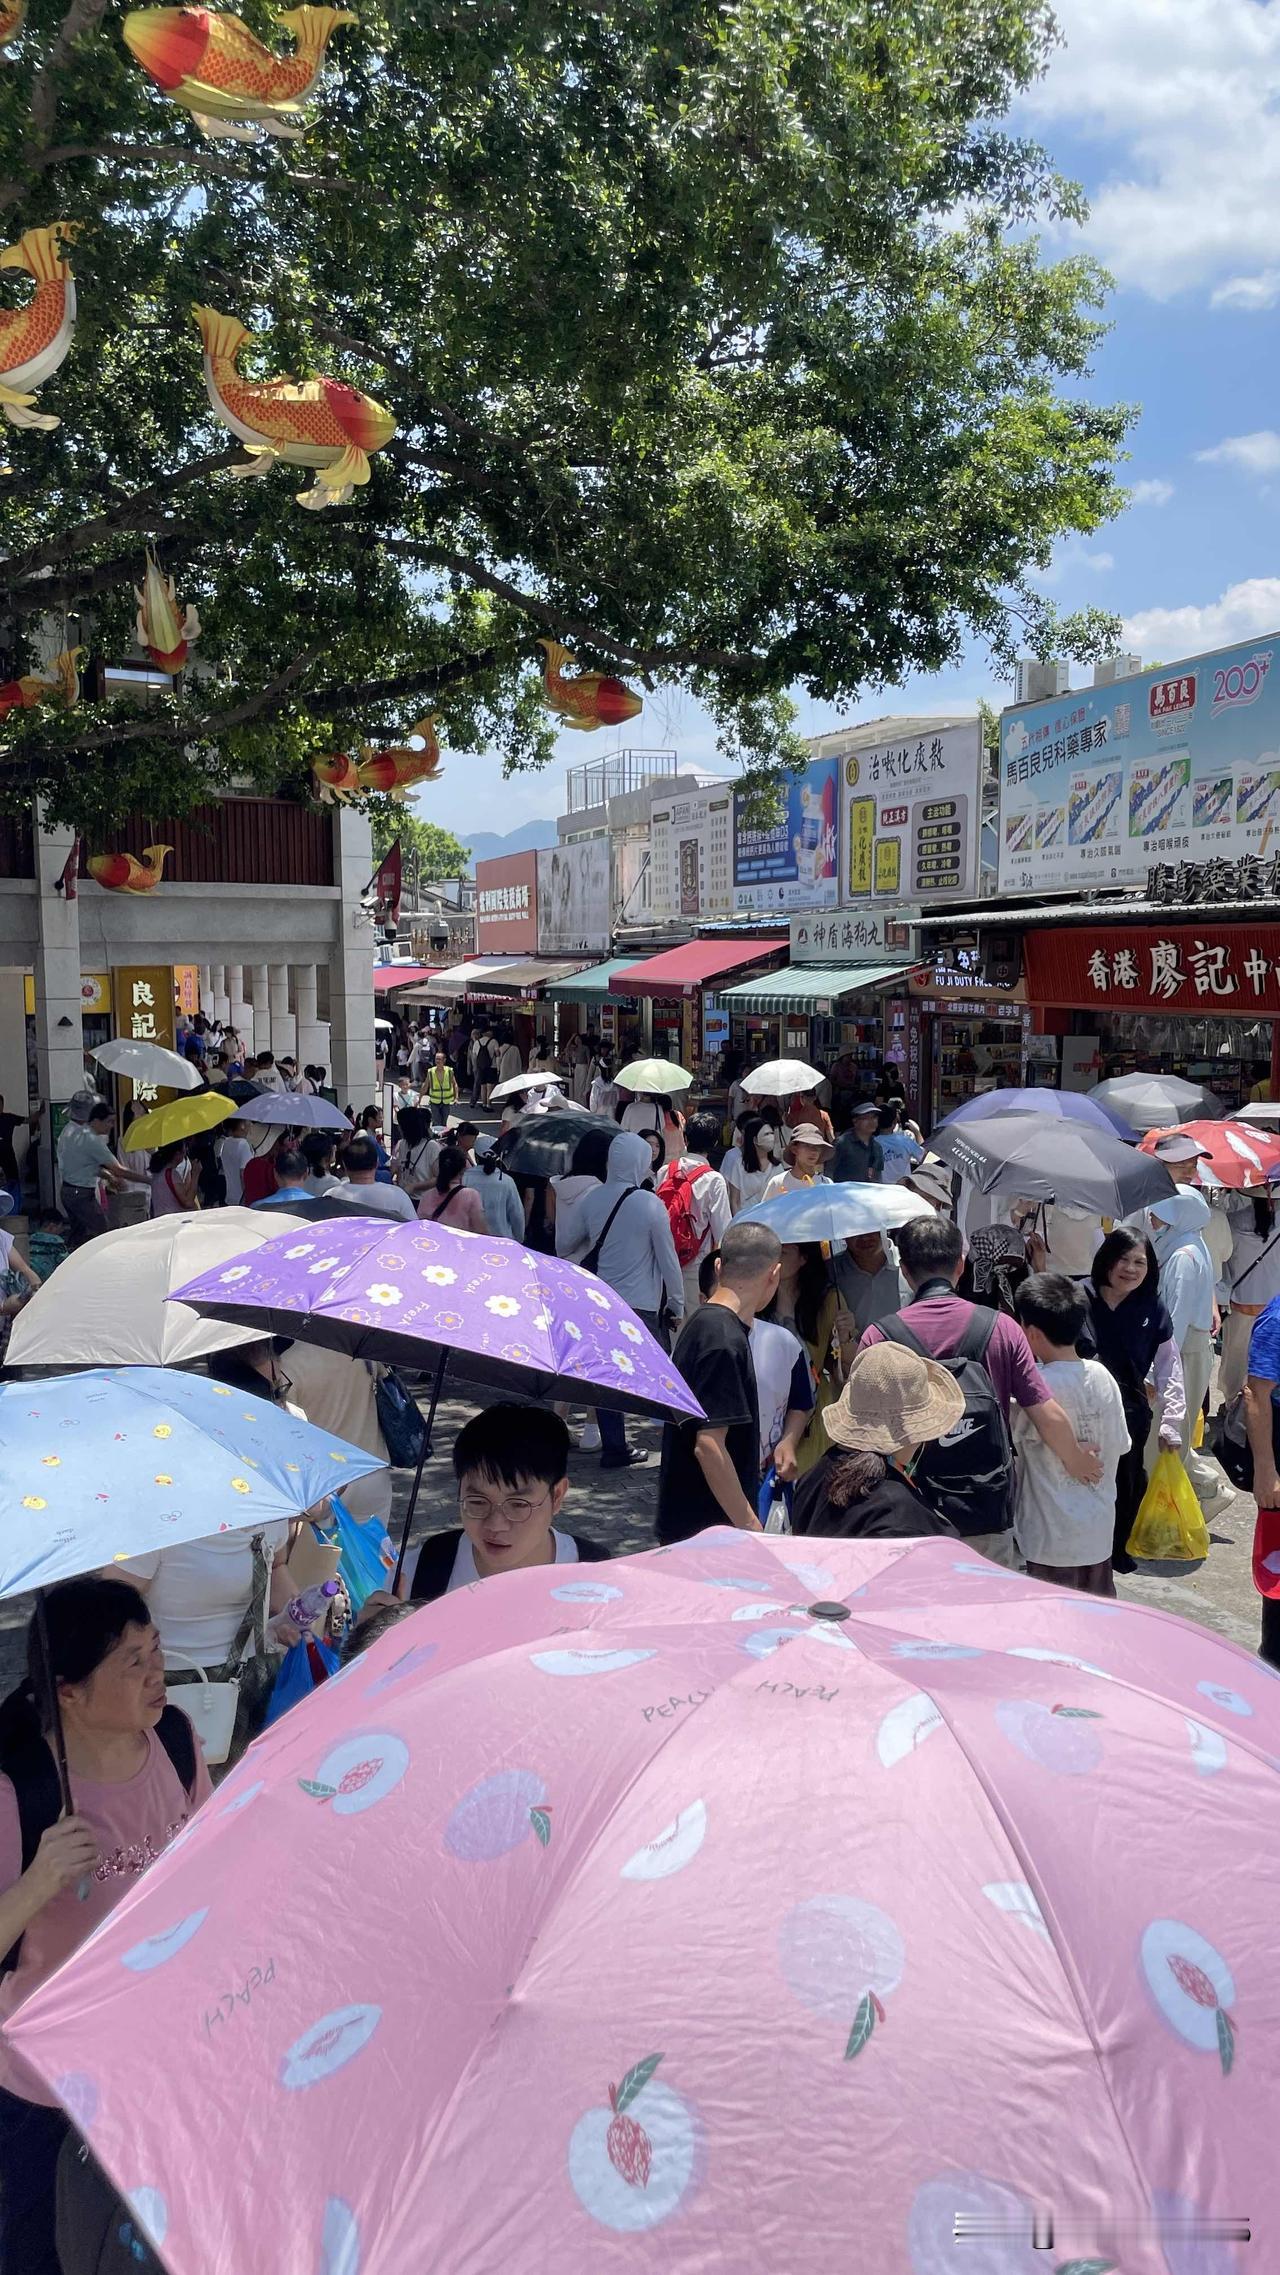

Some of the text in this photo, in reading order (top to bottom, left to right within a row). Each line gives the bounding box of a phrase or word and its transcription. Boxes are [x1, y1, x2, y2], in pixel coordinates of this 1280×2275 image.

[1214, 661, 1269, 703] 200+
[1006, 720, 1107, 786] 馬百良兒科藥專家
[935, 975, 945, 986] FU
[946, 976, 953, 986] JI
[954, 975, 973, 987] DUTY
[1087, 940, 1280, 999] 香港廖記中
[463, 1272, 492, 1295] Fresh
[398, 1301, 431, 1326] Fresh
[949, 1417, 975, 1435] IKE
[757, 1680, 840, 1702] PEACH
[203, 1957, 276, 2040] PEACH
